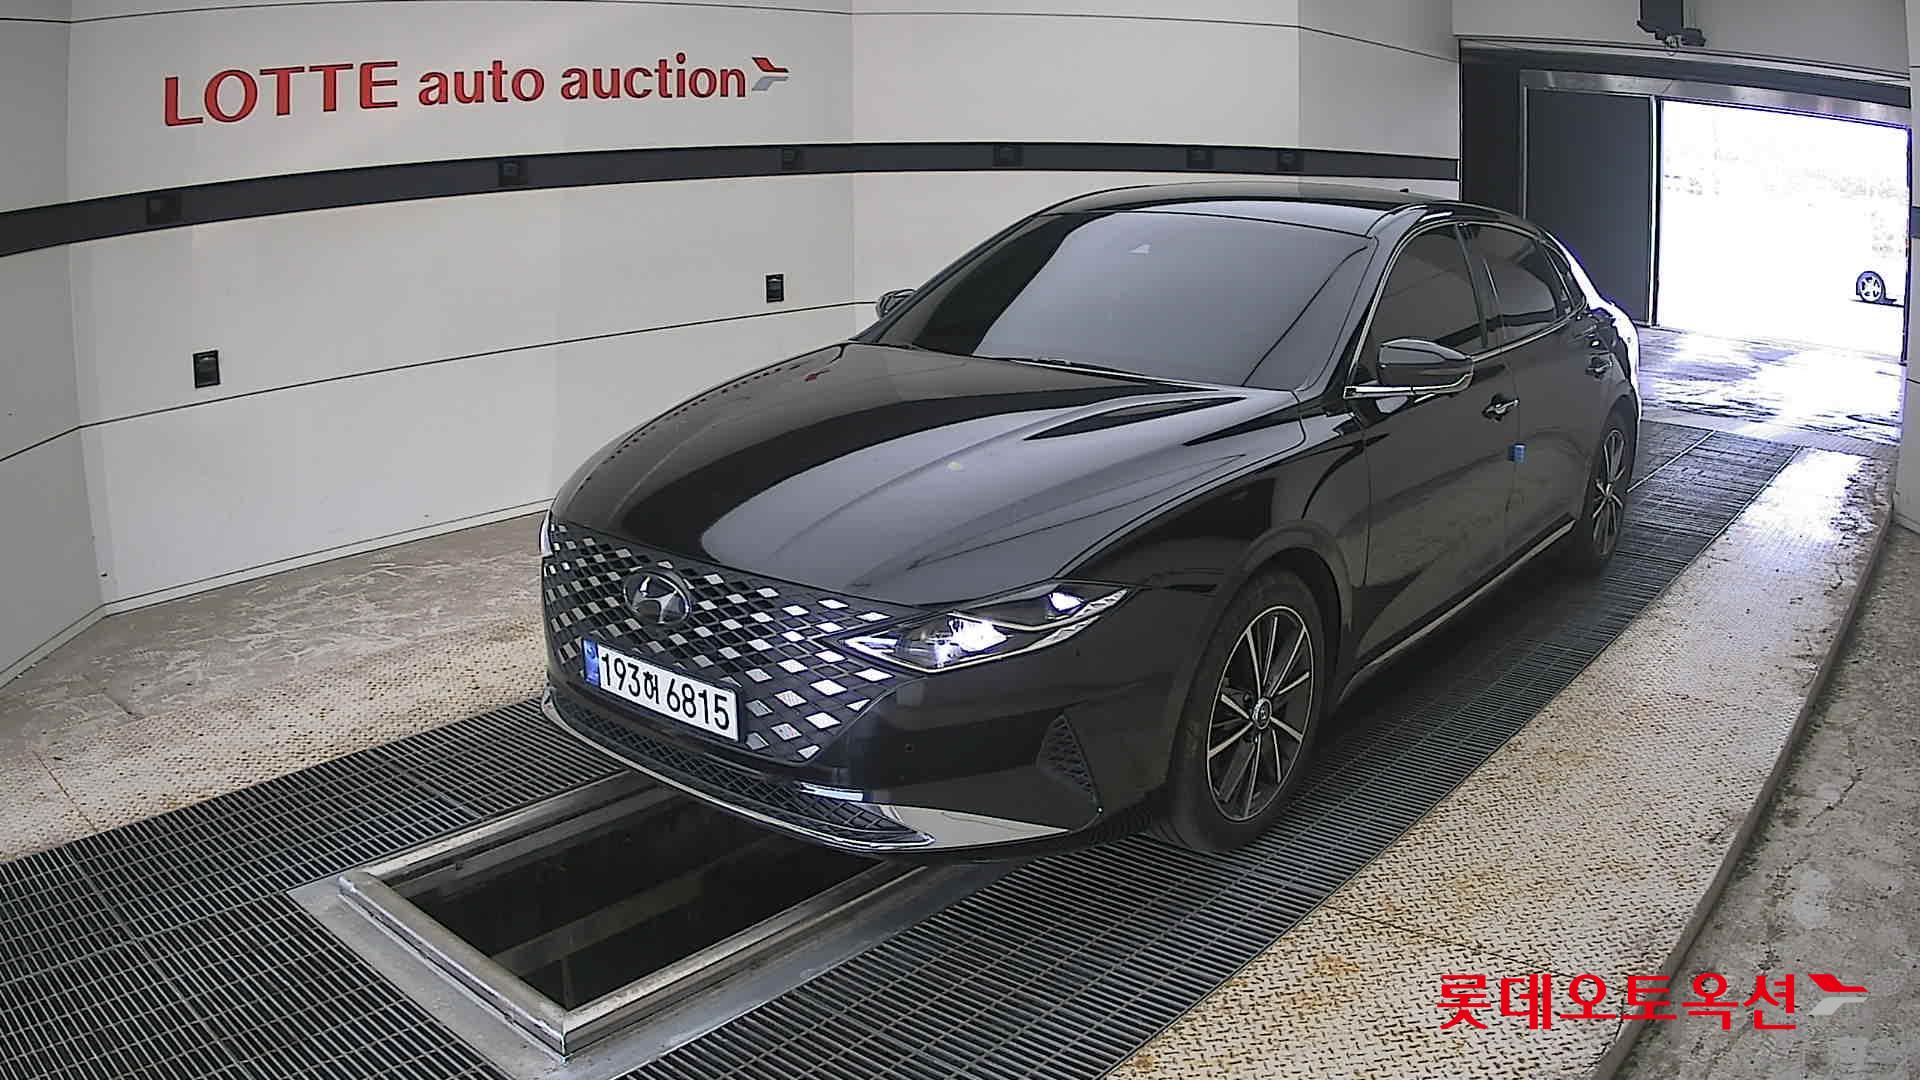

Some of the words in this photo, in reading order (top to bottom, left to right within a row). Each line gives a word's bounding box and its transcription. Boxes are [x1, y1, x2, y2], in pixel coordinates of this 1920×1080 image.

[164, 61, 398, 127] LOTTE
[418, 60, 545, 106] auto
[560, 52, 747, 100] auction
[601, 653, 660, 705] 193허
[667, 678, 730, 730] 6815
